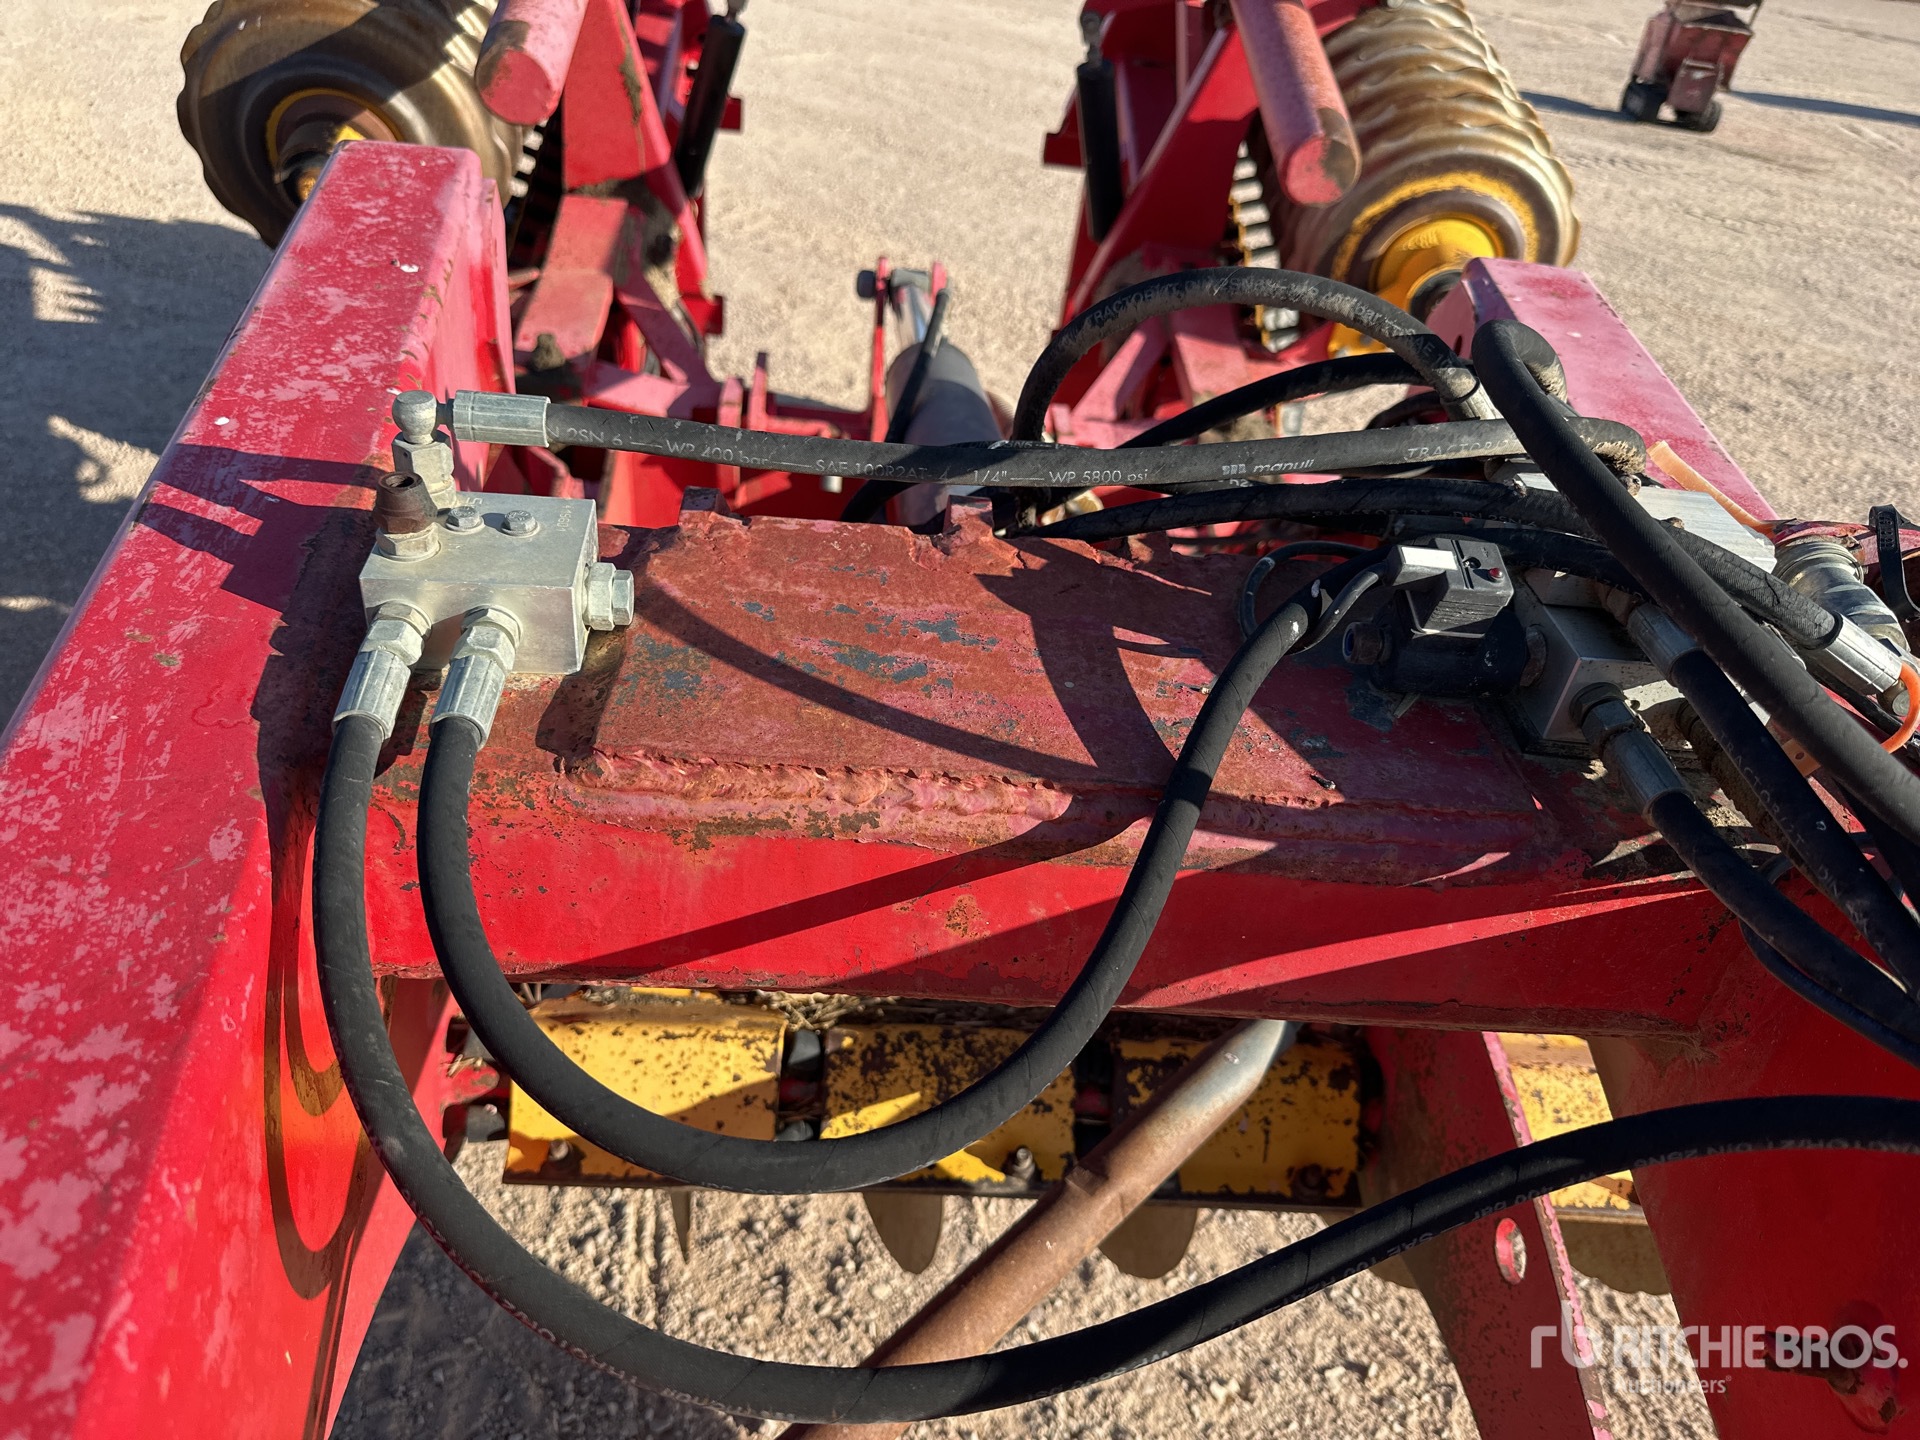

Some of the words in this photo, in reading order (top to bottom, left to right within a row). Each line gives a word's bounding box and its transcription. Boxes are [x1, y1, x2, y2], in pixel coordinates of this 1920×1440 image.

[566, 426, 605, 444] 2SN
[611, 432, 624, 446] 6
[701, 444, 734, 462] 400
[973, 469, 1008, 484] 1/4"
[1048, 470, 1077, 484] WP
[1081, 470, 1123, 484] 5800
